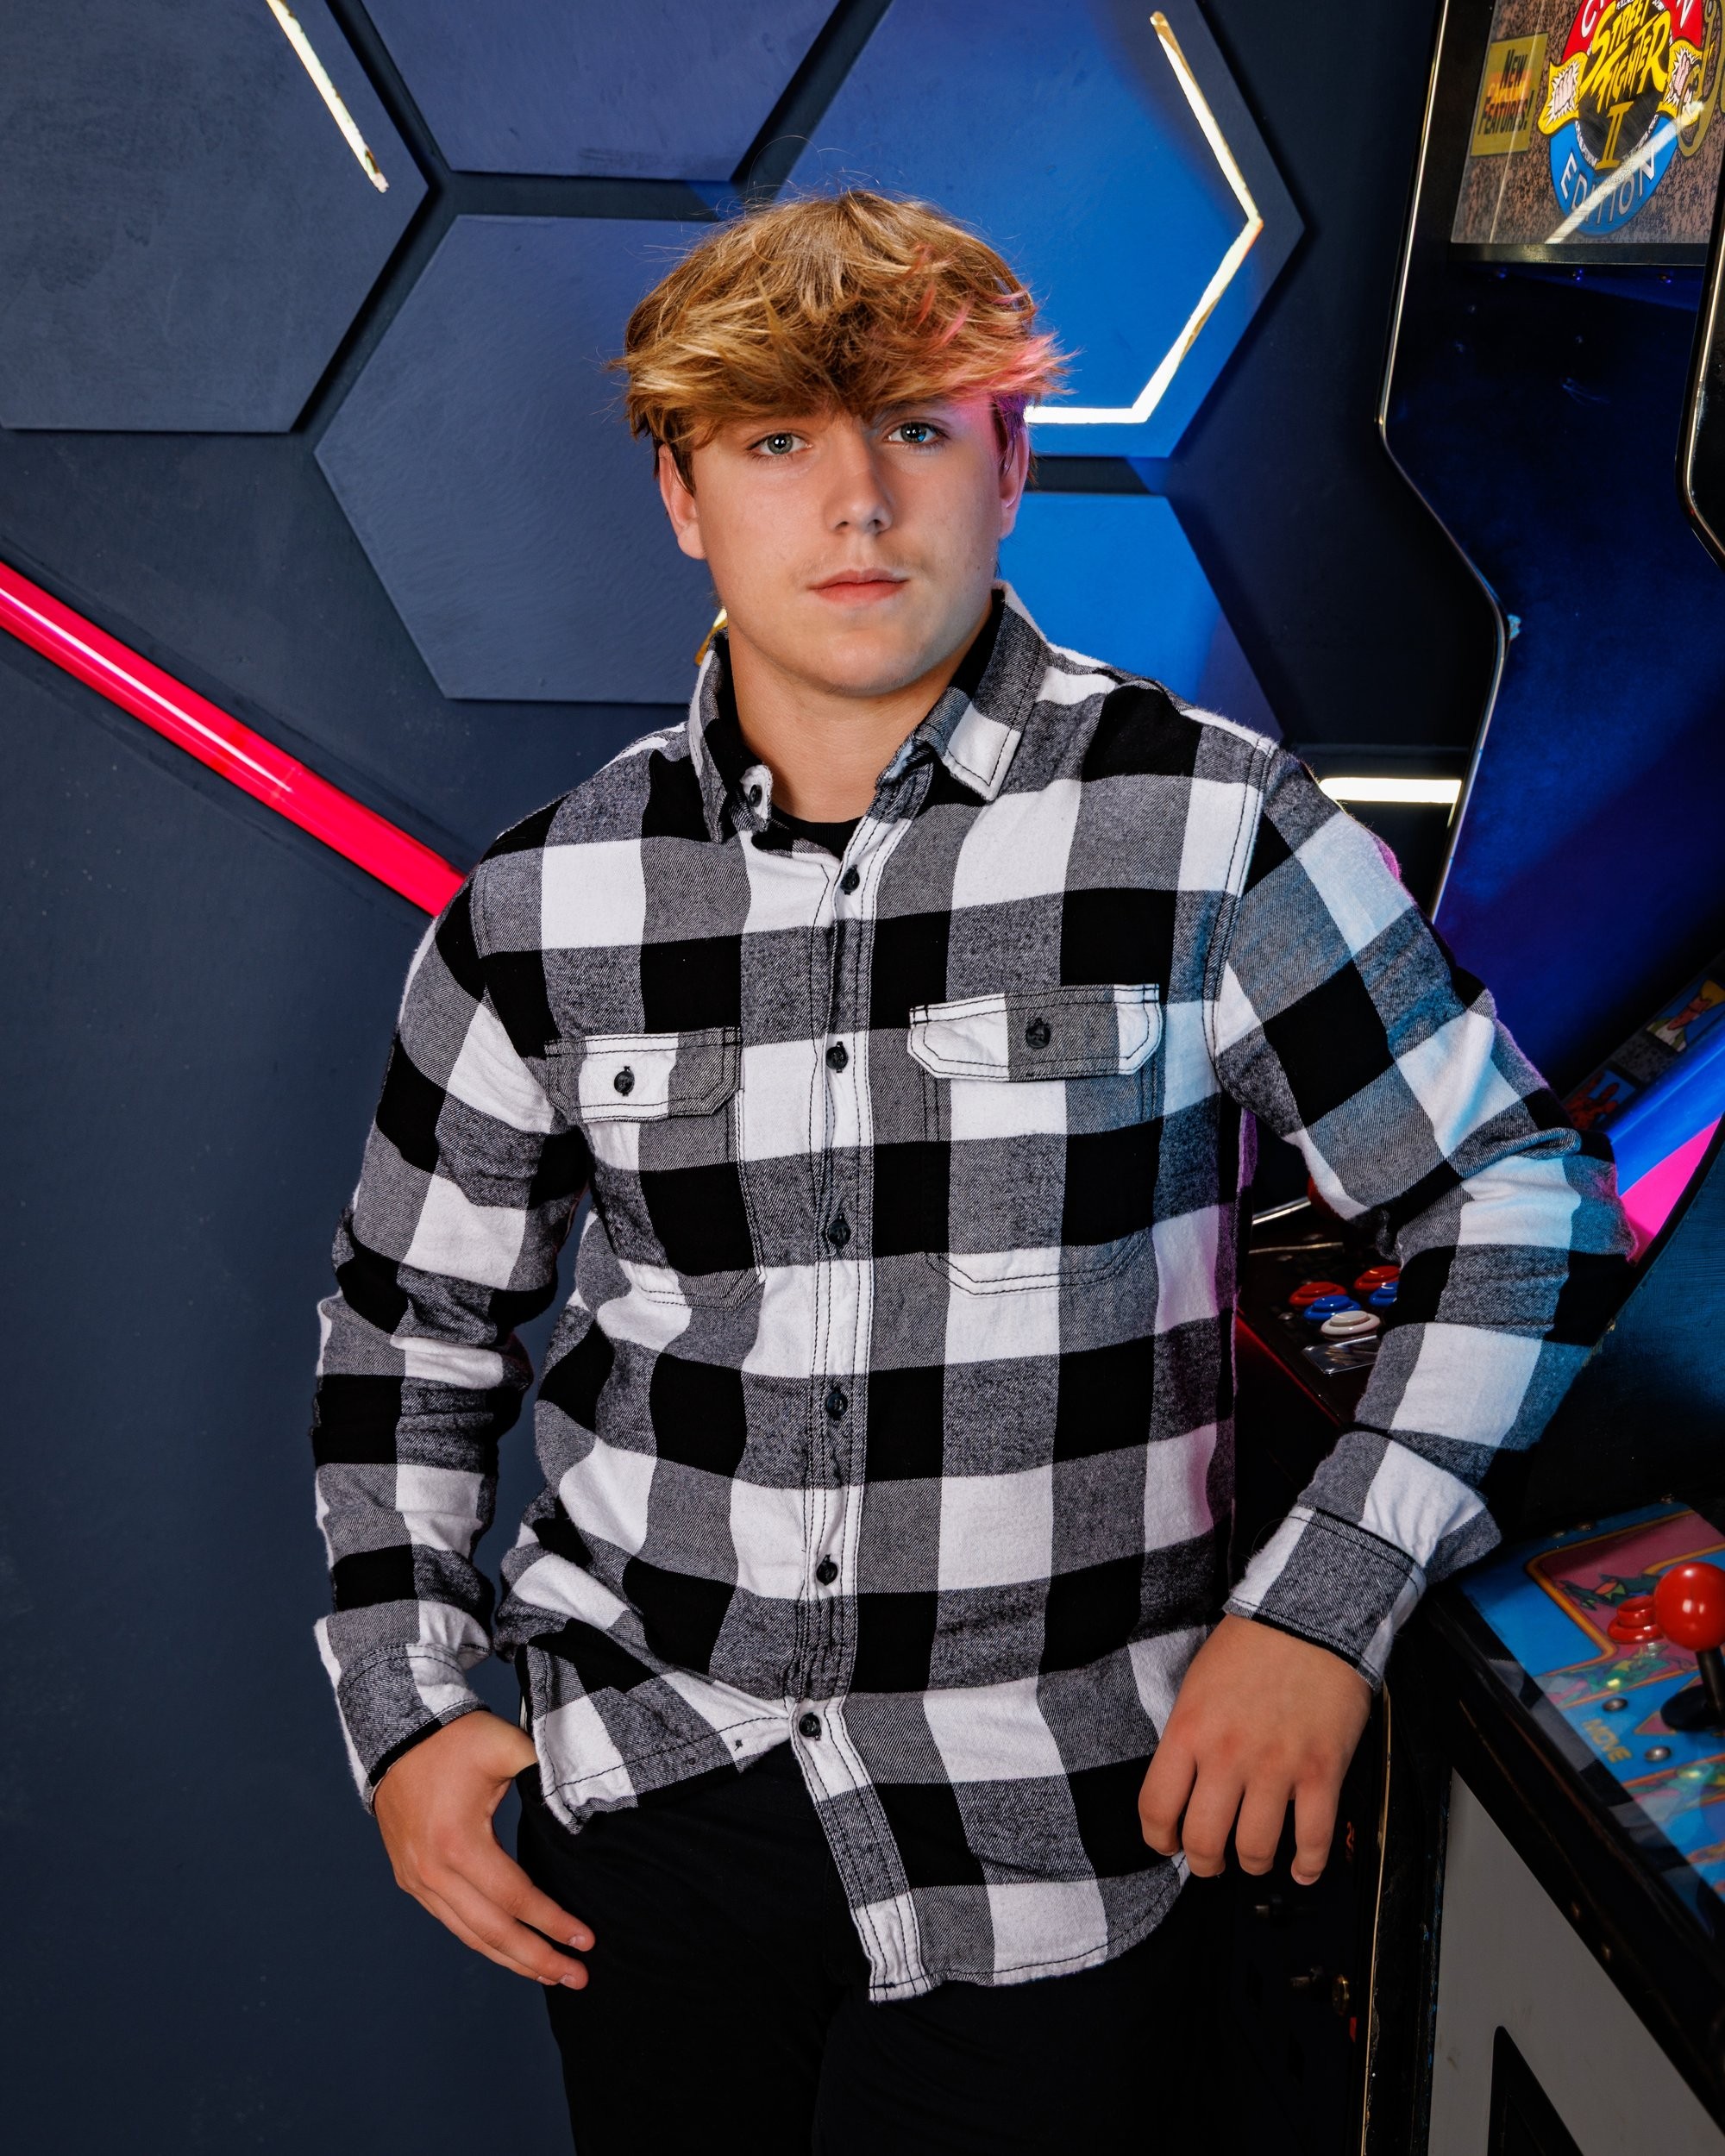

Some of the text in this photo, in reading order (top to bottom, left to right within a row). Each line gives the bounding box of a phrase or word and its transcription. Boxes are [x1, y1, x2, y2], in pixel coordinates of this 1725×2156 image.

[1500, 49, 1528, 90] NEW
[1590, 10, 1669, 113] FIGHTER
[1581, 1718, 1632, 1763] MOVE
